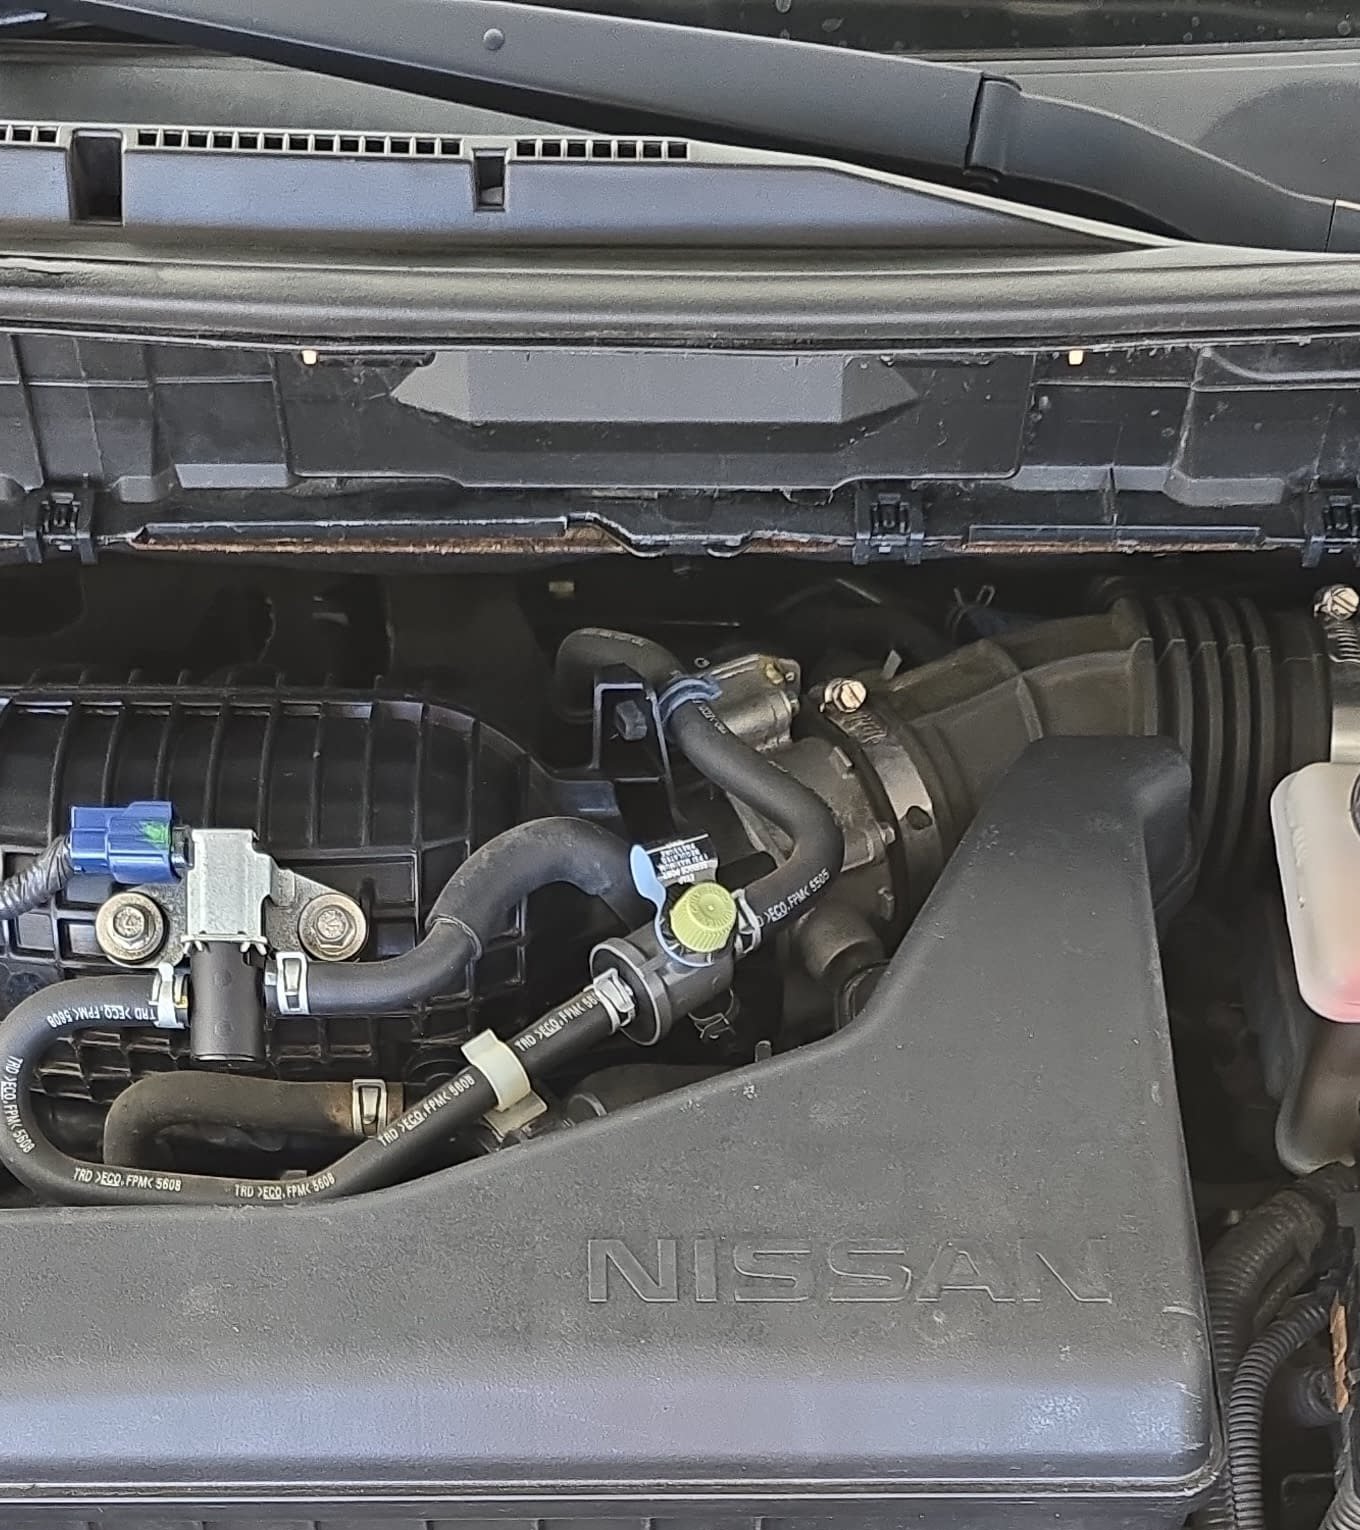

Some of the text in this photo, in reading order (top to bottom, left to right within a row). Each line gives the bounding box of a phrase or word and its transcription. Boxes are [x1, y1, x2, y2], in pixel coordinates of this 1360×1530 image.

[135, 1007, 156, 1020] TRD
[515, 1034, 537, 1053] TRD
[4, 1055, 24, 1075] TRD
[377, 1128, 399, 1147] TRD
[73, 1168, 93, 1183] TRD
[234, 1184, 255, 1198] TRD
[586, 1237, 1114, 1305] NISSAN
